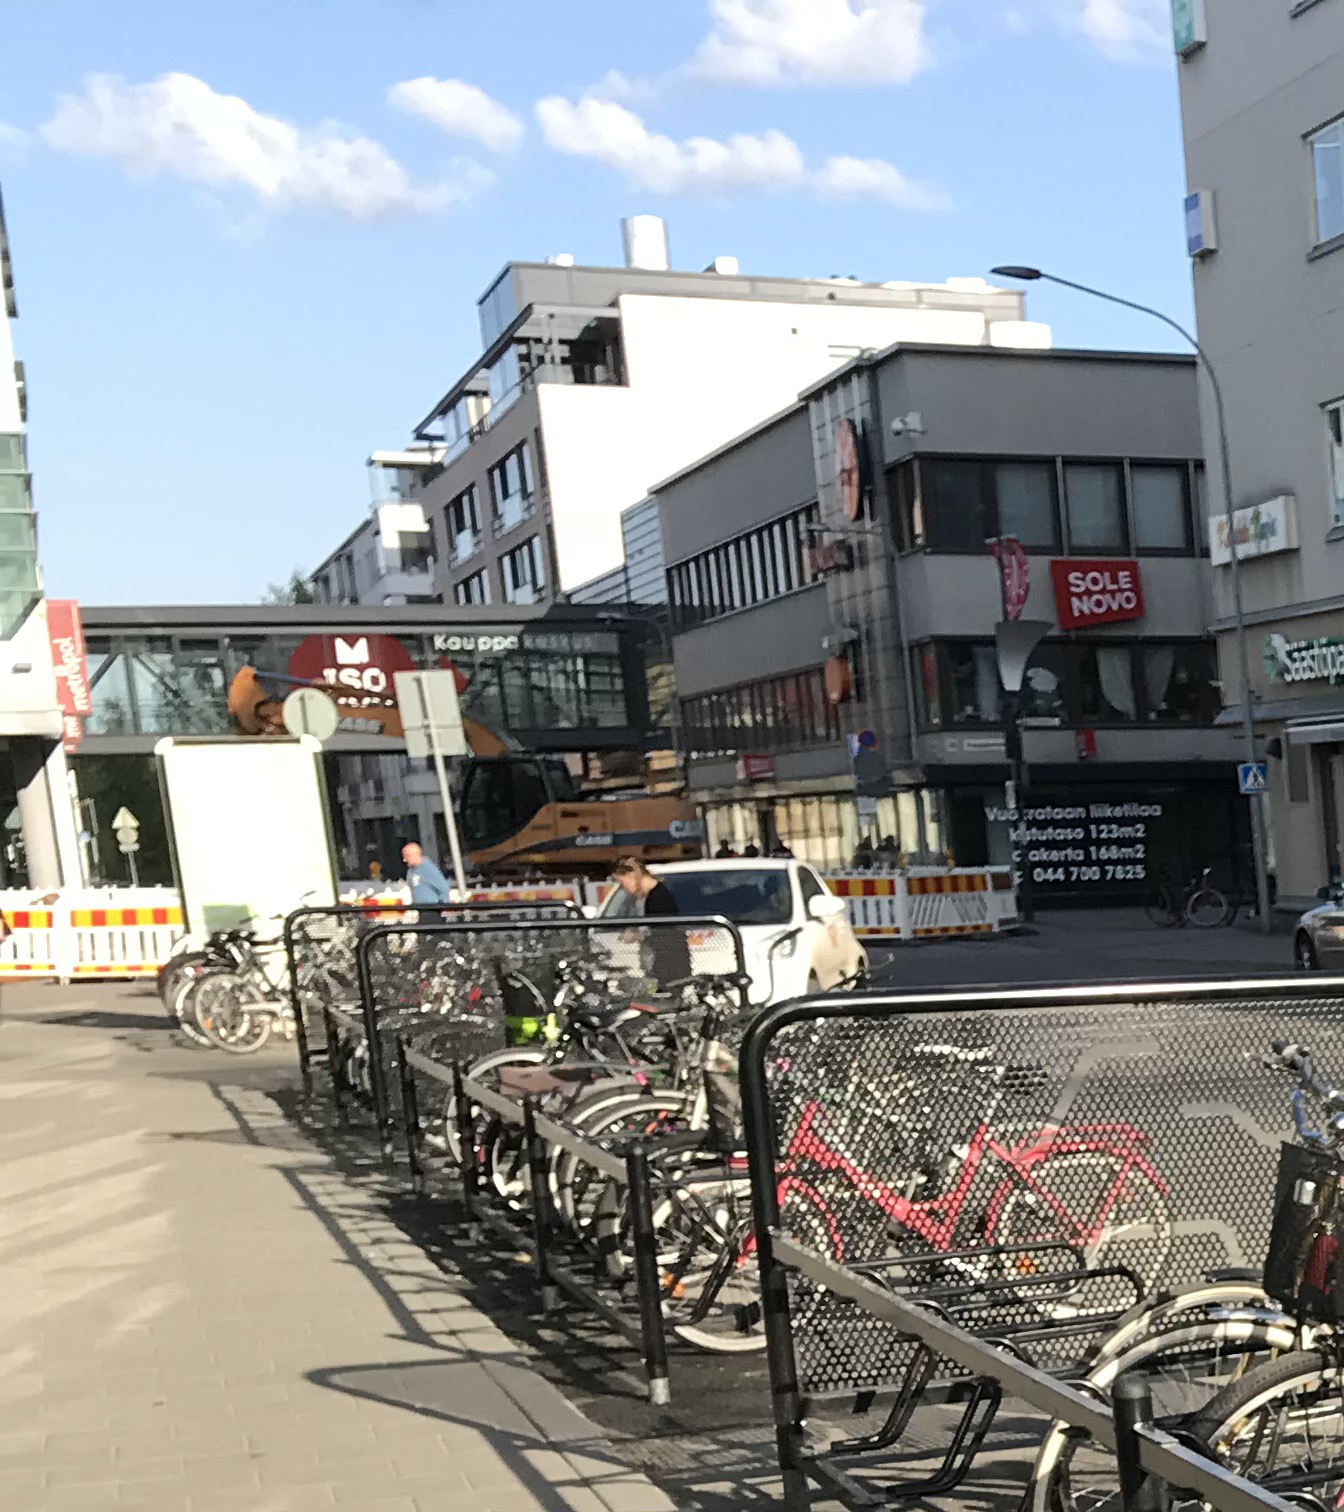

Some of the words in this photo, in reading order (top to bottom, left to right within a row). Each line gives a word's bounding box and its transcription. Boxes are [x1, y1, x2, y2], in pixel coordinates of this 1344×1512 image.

[1068, 571, 1133, 593] SOLE
[1070, 591, 1137, 616] NOVO
[984, 805, 1087, 821] Vuorataan
[1089, 823, 1146, 839] 123m2
[1033, 867, 1066, 883] 044
[1069, 865, 1101, 882] 700
[1104, 864, 1146, 881] 7825
